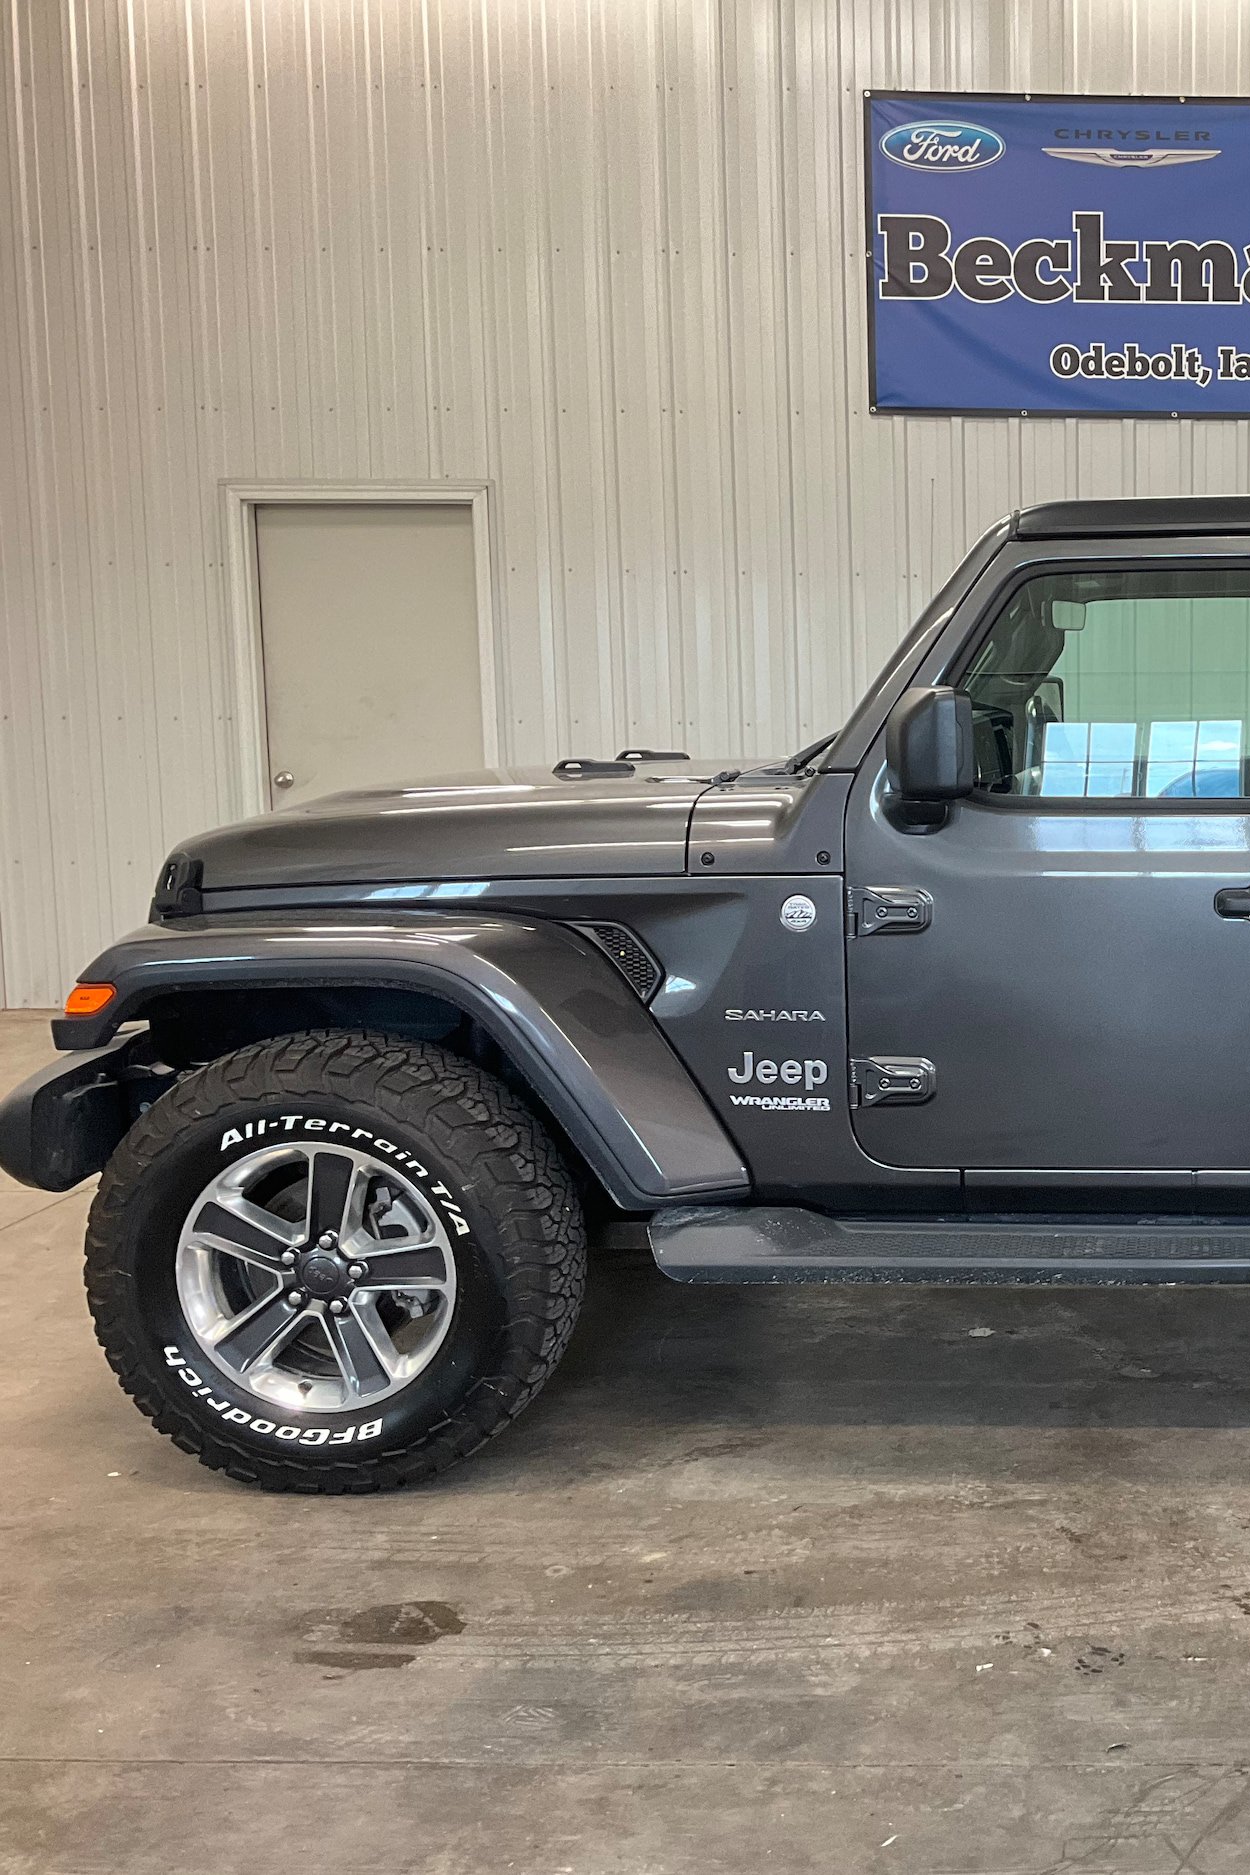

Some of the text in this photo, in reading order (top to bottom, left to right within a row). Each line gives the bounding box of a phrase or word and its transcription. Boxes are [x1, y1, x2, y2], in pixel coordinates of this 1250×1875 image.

[902, 130, 980, 163] Ford
[1054, 128, 1211, 141] CHRYSLER
[1050, 343, 1212, 387] Odebolt,
[725, 1009, 826, 1022] SAHARA
[727, 1051, 828, 1091] Jeep
[729, 1095, 830, 1107] WRANGLER
[219, 1115, 471, 1237] All-Terrain T/A
[162, 1345, 384, 1446] BFGoodrich
